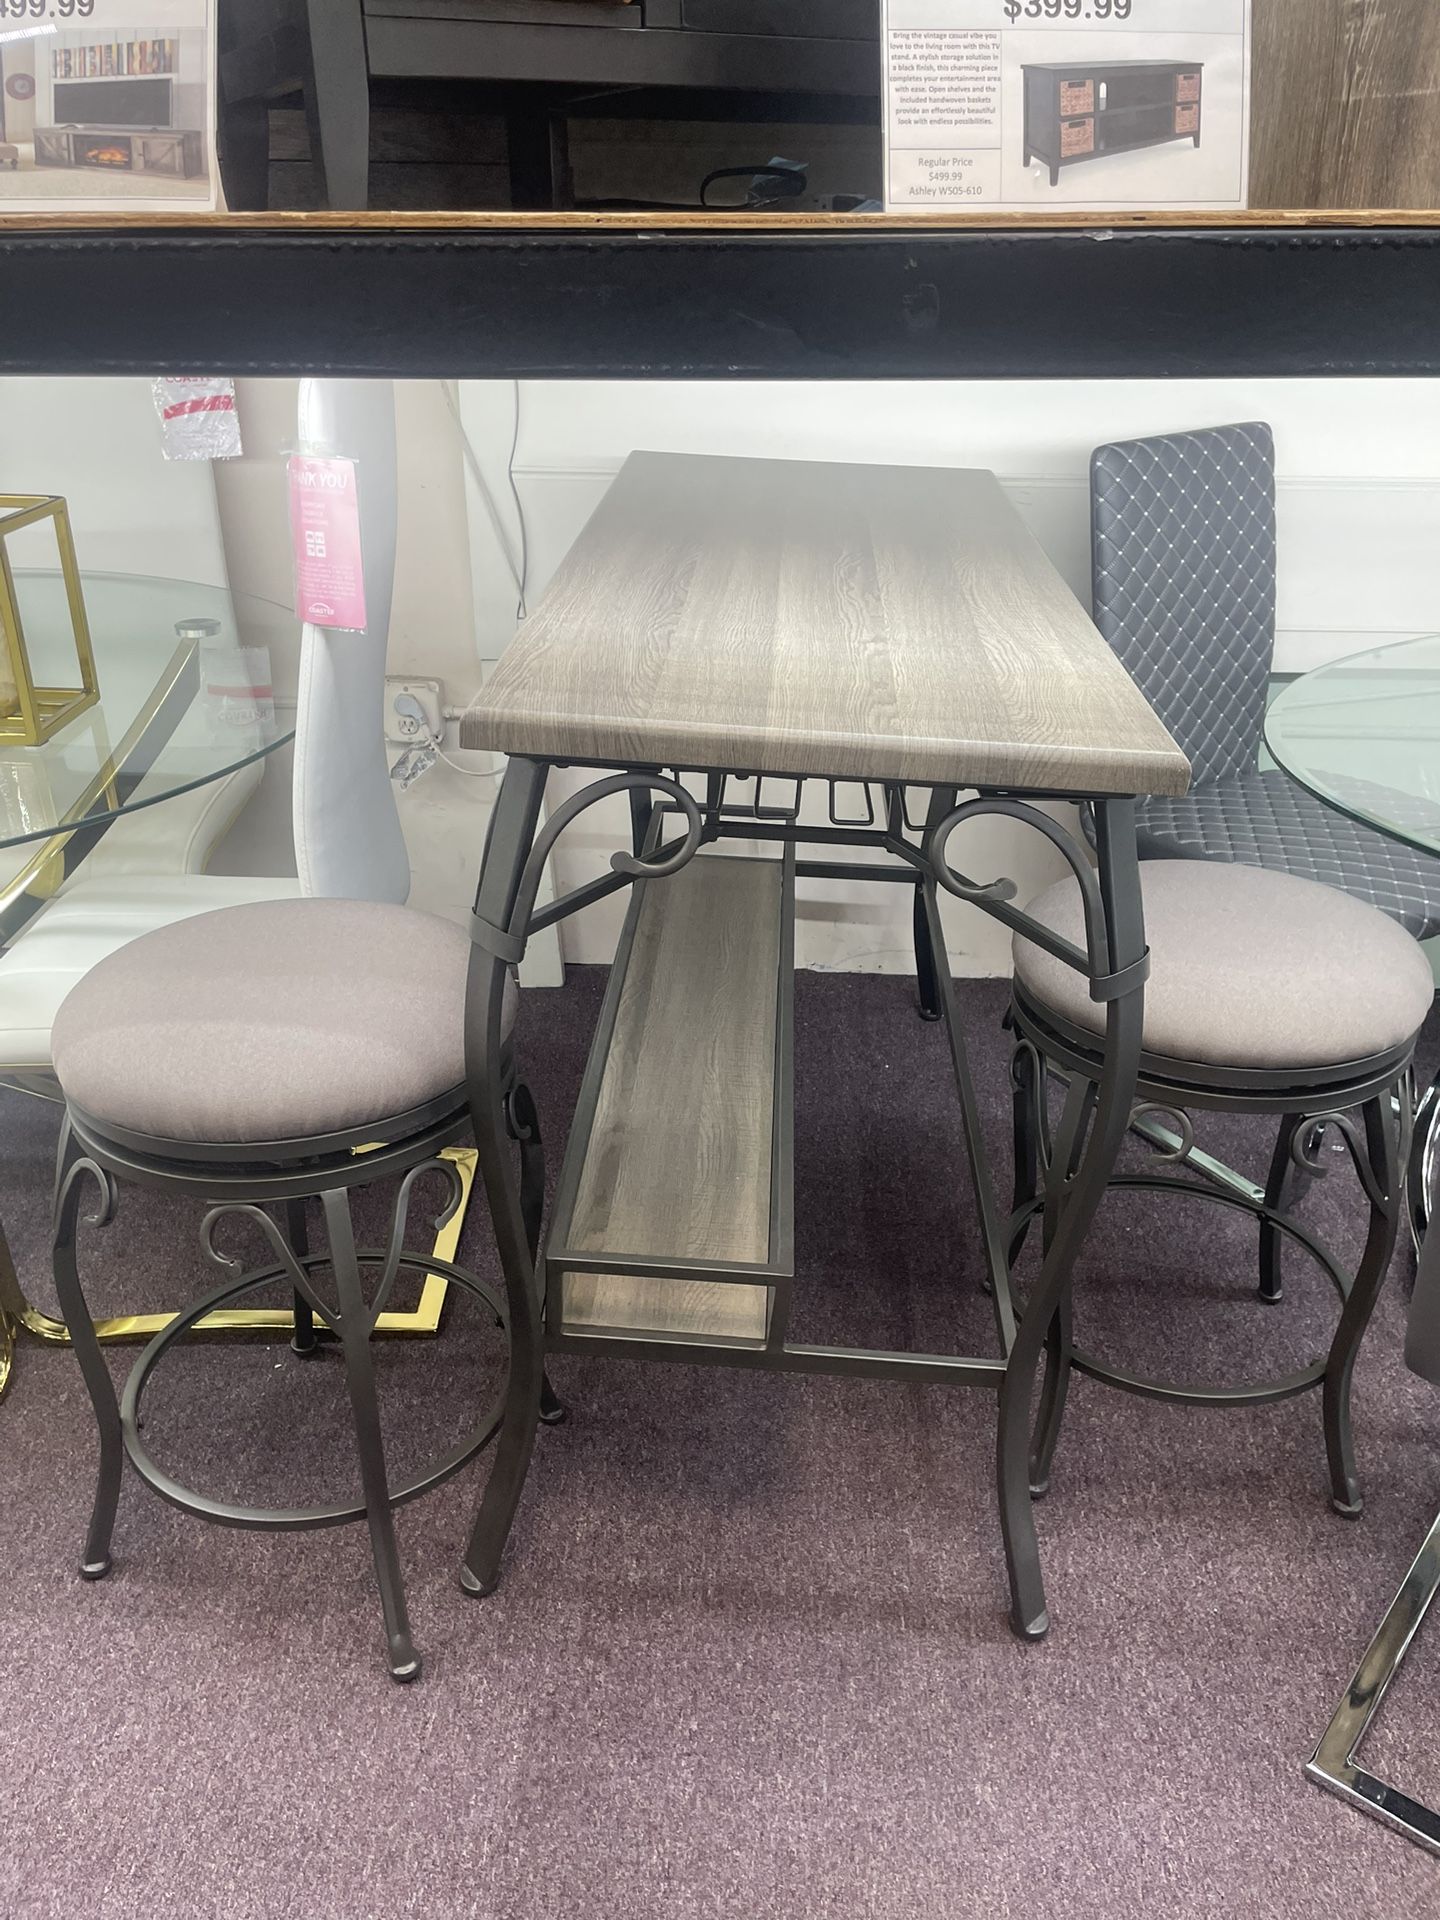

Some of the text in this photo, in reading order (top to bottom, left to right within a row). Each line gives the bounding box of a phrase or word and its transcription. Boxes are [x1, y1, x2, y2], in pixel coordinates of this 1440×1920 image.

[1003, 0, 1132, 24] $399.99
[926, 43, 942, 51] living
[916, 64, 936, 72] finish,
[951, 64, 980, 72] charming
[981, 64, 998, 72] piece
[889, 75, 922, 83] completes
[929, 86, 945, 94] Open
[895, 107, 919, 115] provide
[931, 107, 967, 115] effortlessly
[954, 118, 993, 126] possibilities.
[918, 157, 974, 168] Regular Price
[928, 171, 963, 181] $499.99
[909, 186, 982, 197] Ashley W505-610
[320, 471, 348, 488] YOU
